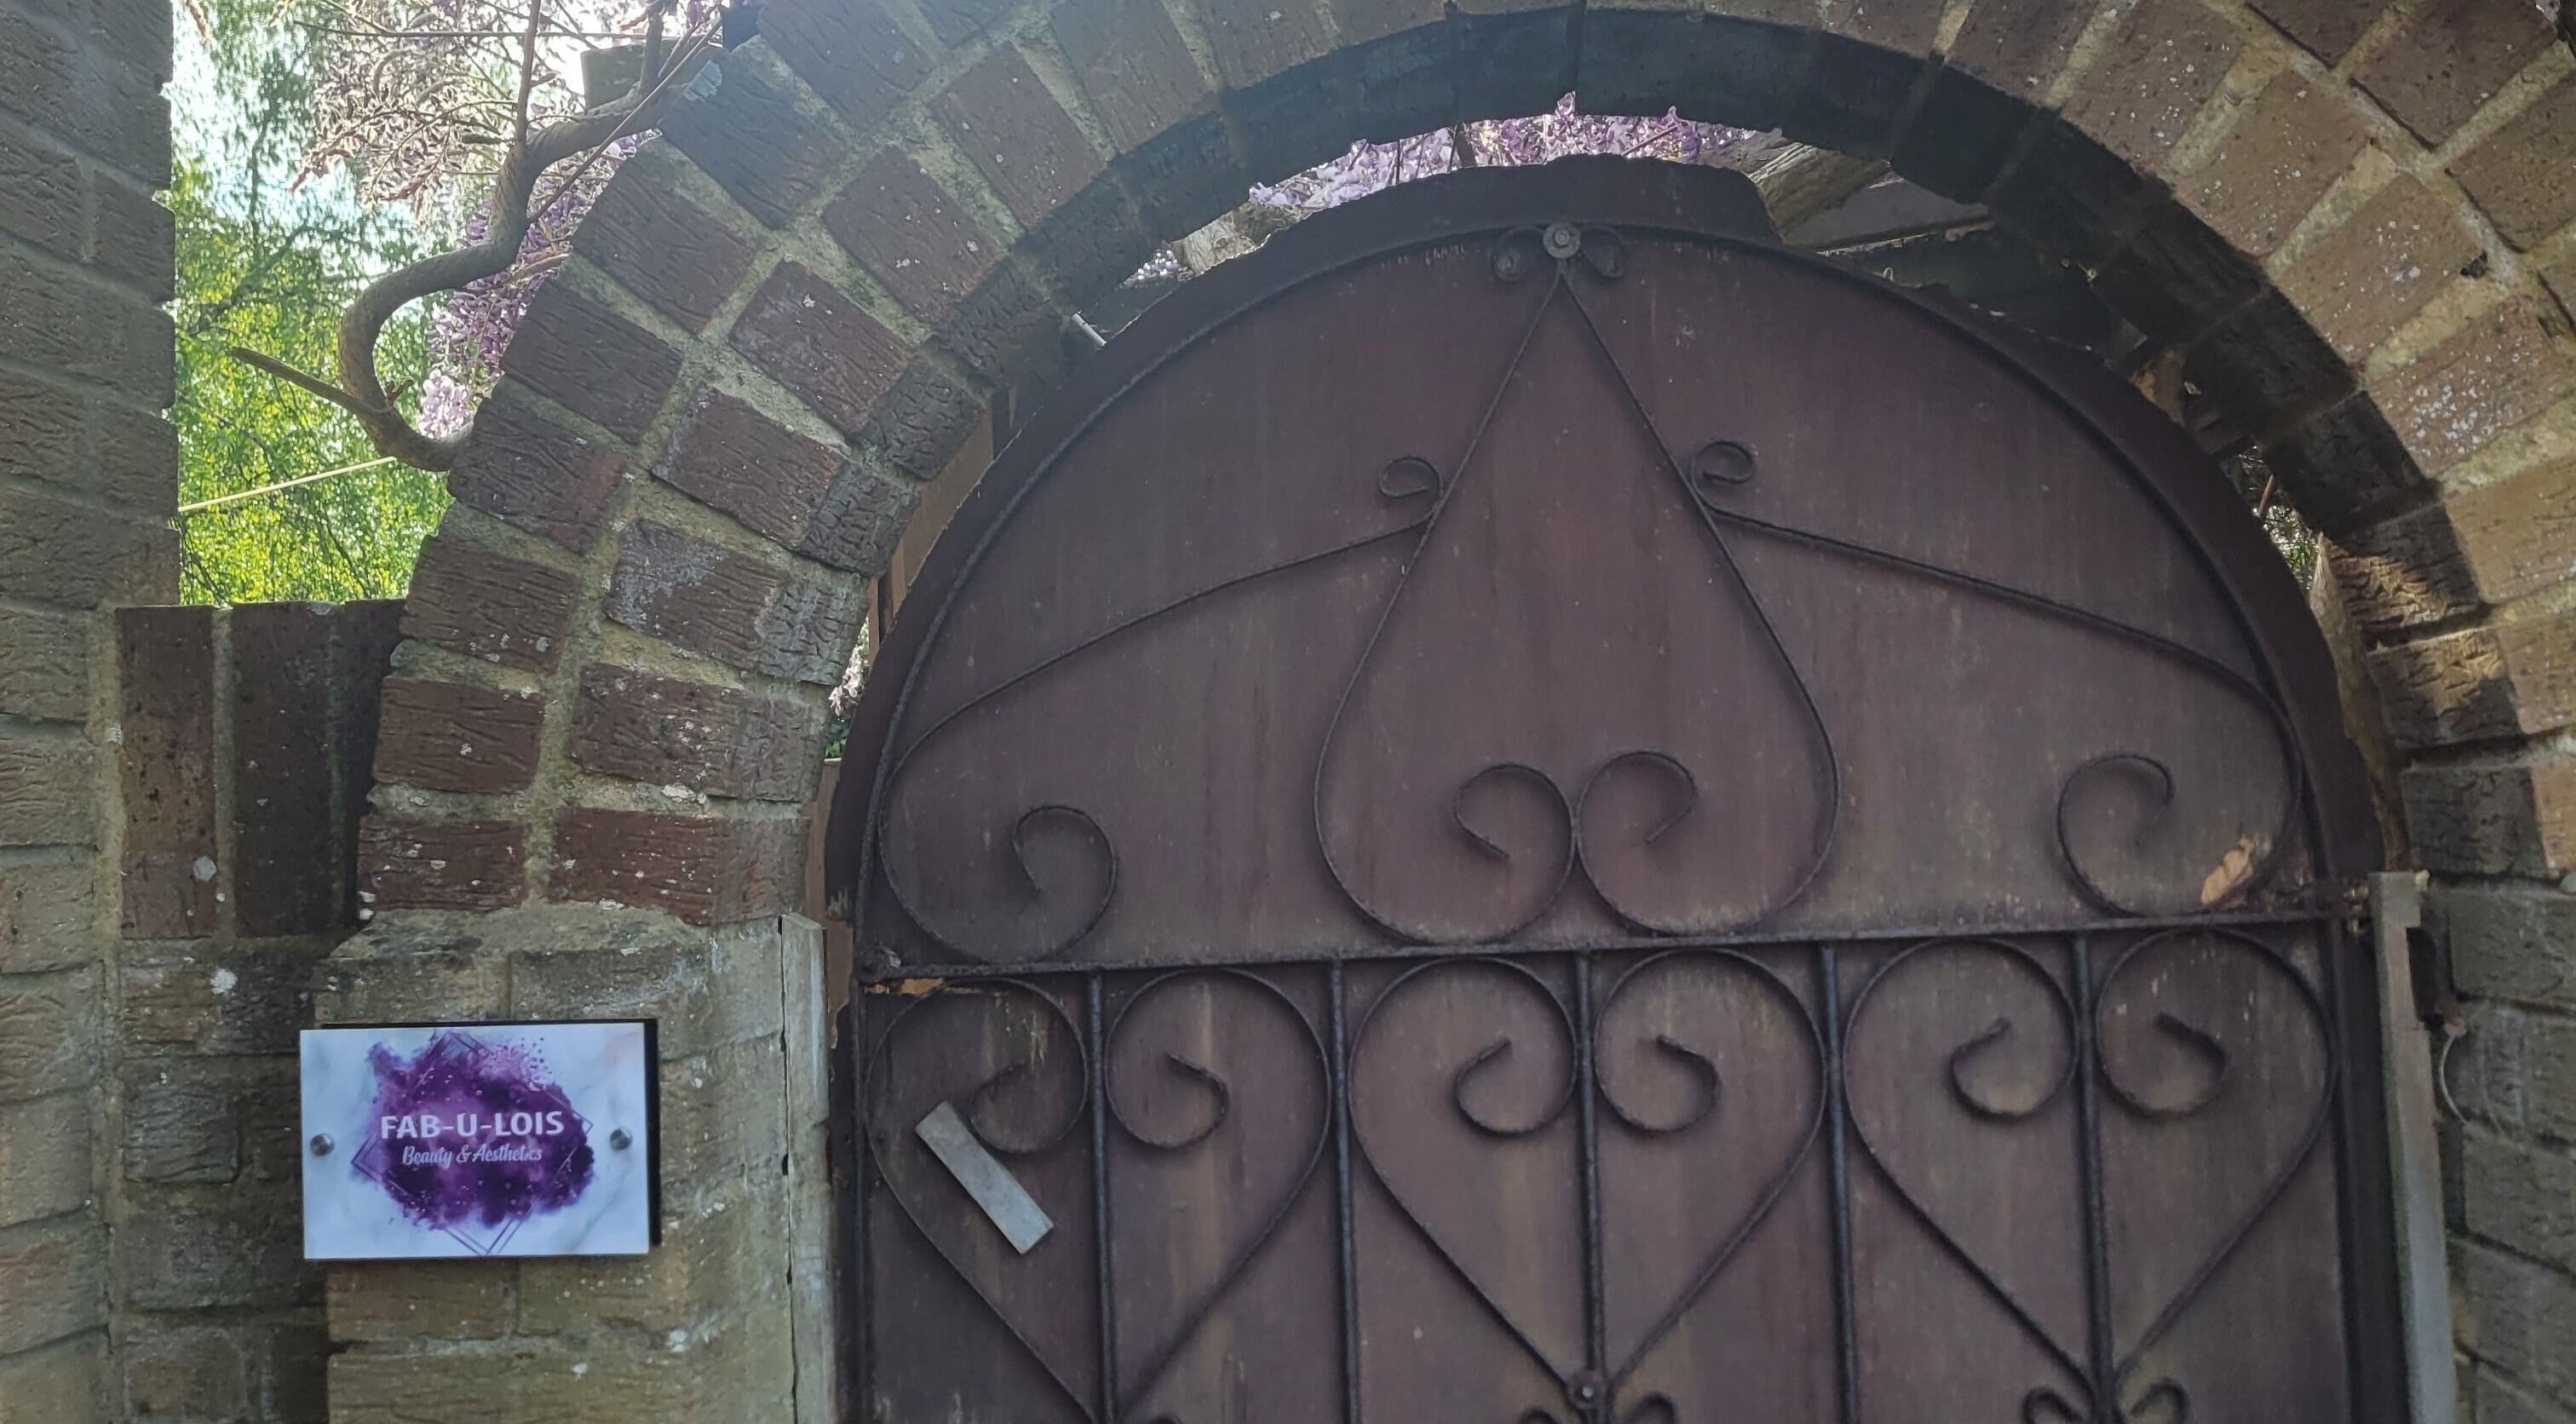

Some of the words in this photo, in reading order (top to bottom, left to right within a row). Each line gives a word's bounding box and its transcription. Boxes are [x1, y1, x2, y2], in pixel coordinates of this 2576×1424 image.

[381, 1111, 564, 1139] FAB-U-LOIS
[402, 1145, 453, 1168] Beauty
[456, 1144, 472, 1163] &
[472, 1143, 543, 1163] Aesthetics
